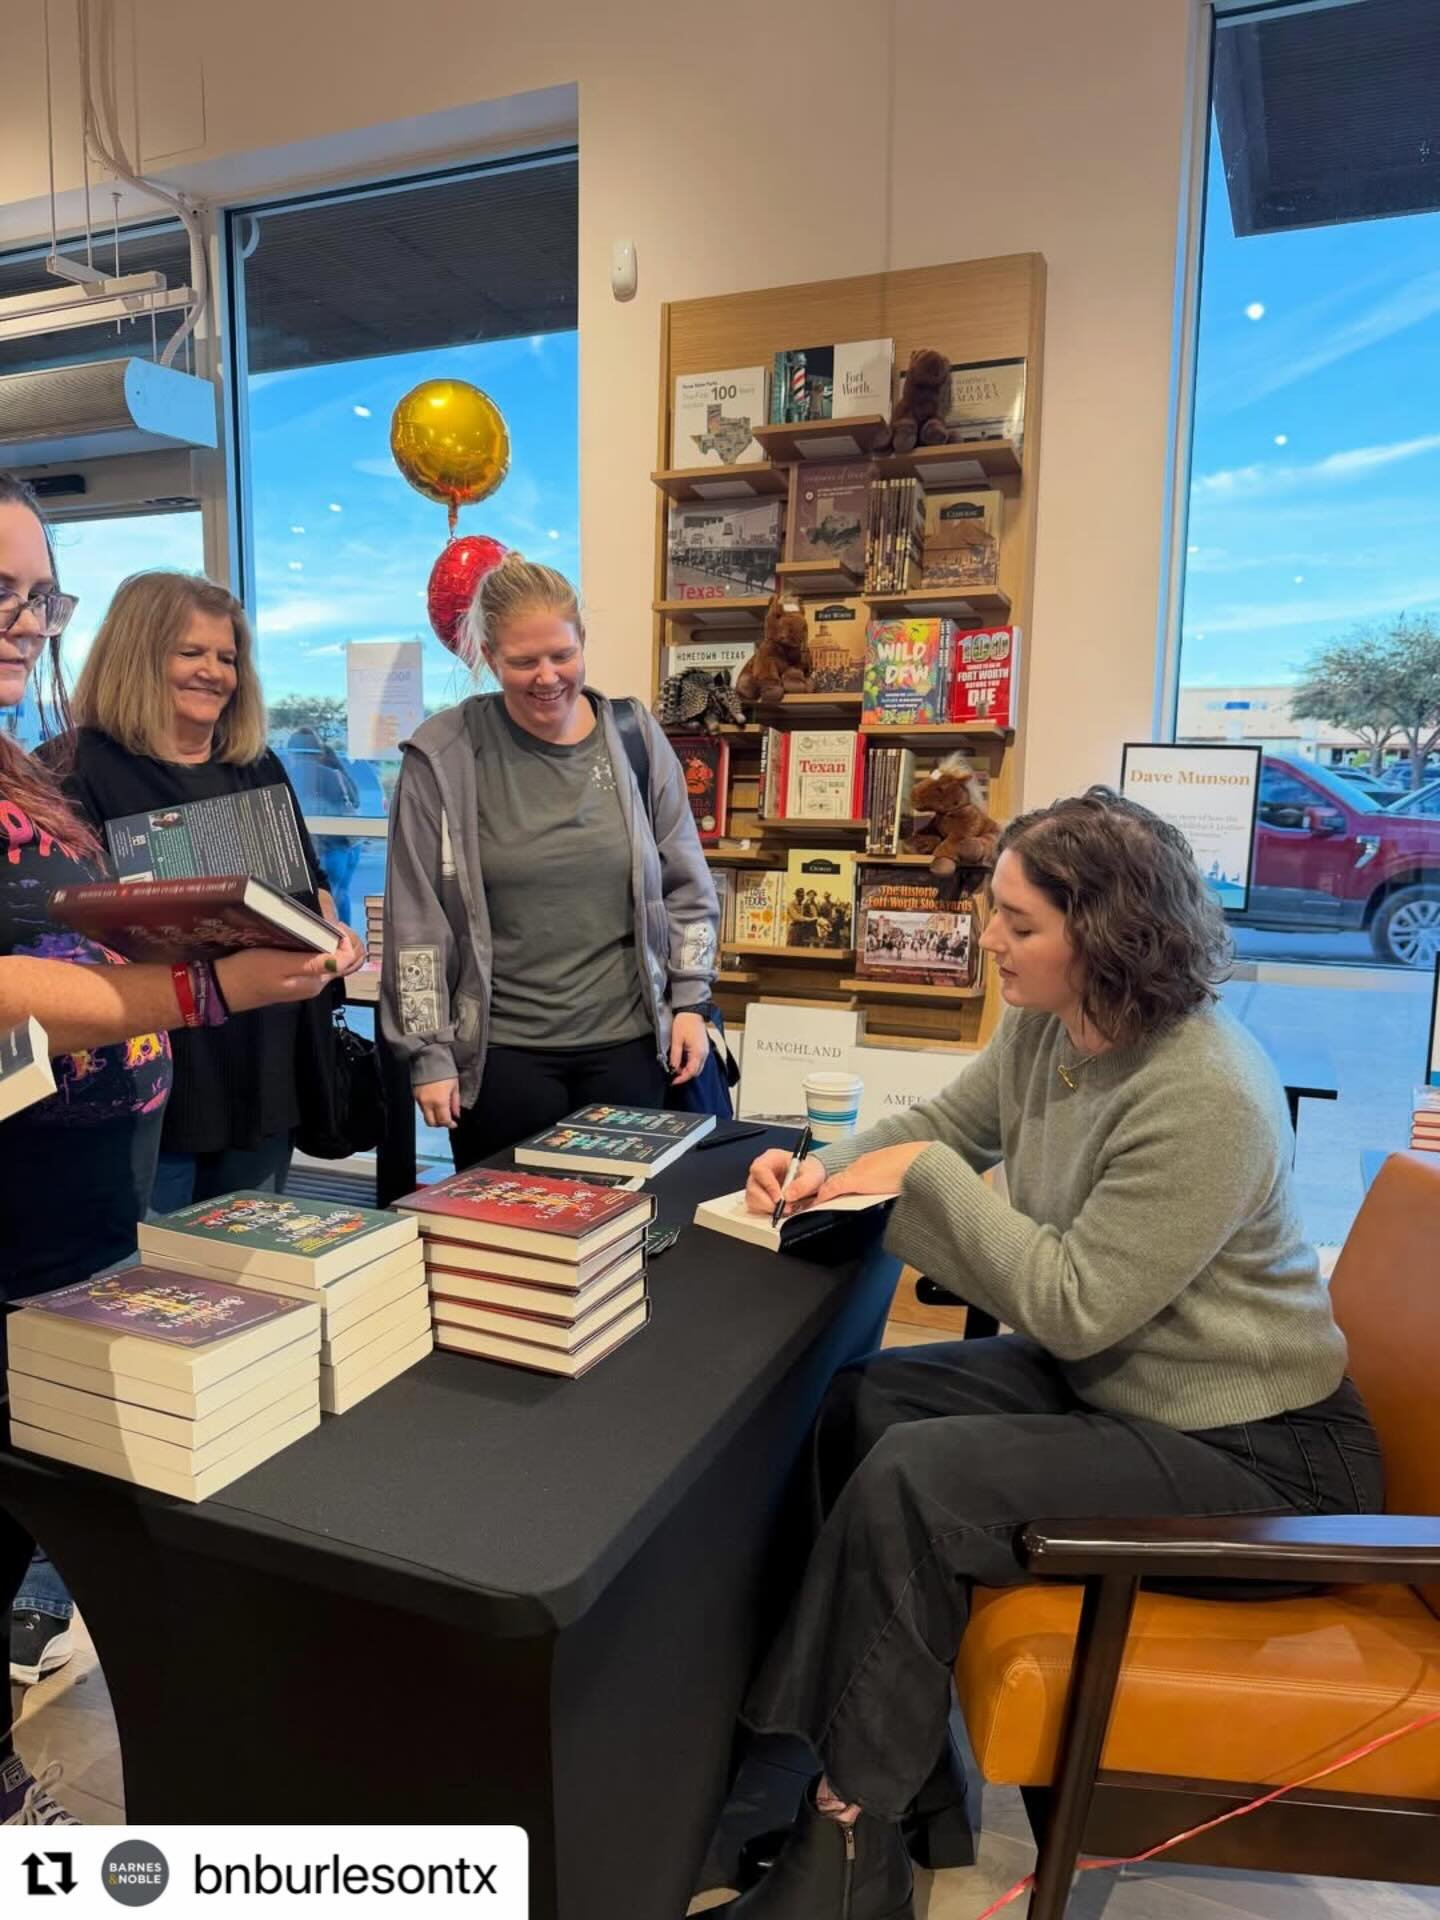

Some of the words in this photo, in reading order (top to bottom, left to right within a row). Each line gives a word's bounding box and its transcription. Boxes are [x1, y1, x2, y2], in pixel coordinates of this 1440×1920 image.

[711, 384, 737, 401] 100
[676, 582, 725, 600] Texas
[676, 651, 717, 661] HOMETOWN
[720, 650, 746, 660] TEXAS
[877, 641, 927, 662] WILD
[958, 631, 1010, 663] 100
[884, 663, 930, 684] DFW
[958, 671, 978, 682] FORT
[978, 667, 1009, 681] WORTH
[967, 687, 997, 707] DIE
[799, 759, 846, 774] Texan
[1130, 768, 1173, 784] Dave
[1177, 770, 1251, 786] Munson
[868, 895, 888, 909] Fort
[756, 1039, 842, 1058] RANCHLAND
